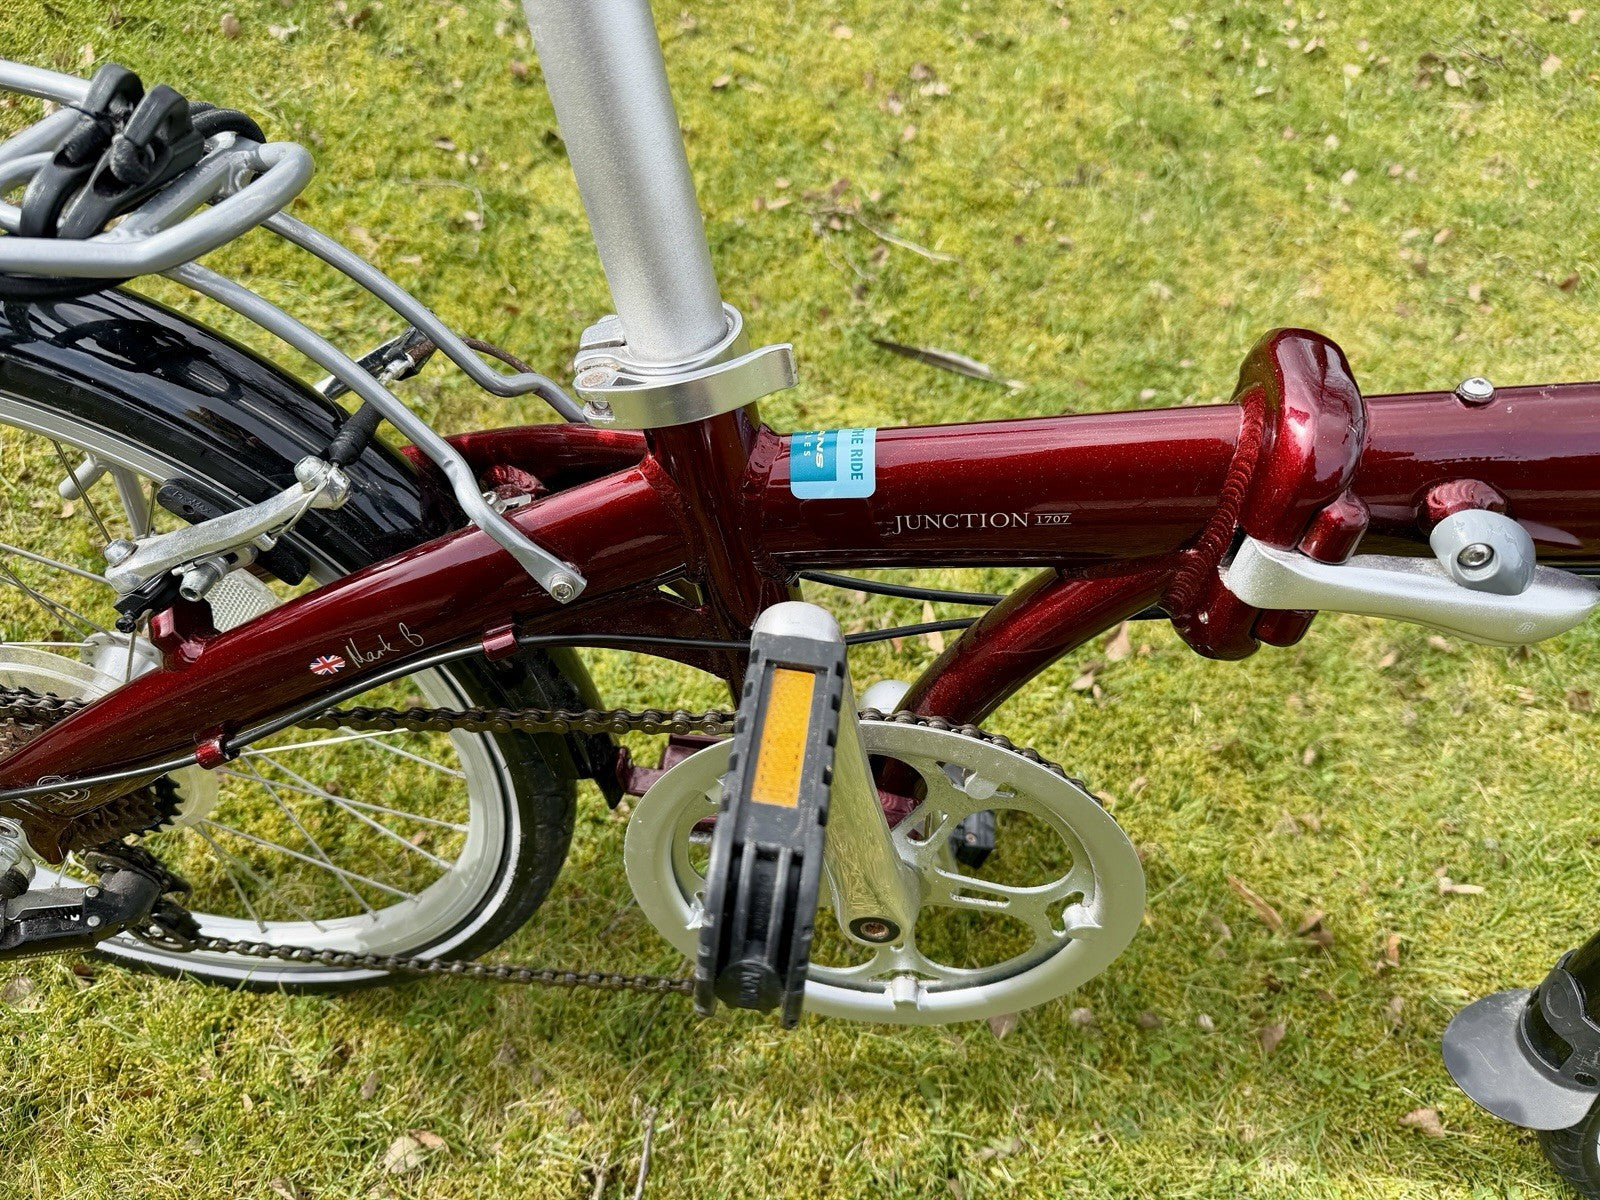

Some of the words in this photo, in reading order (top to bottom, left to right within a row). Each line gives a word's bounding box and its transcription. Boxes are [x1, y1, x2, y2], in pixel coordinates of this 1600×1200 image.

[850, 449, 864, 481] RIDE
[894, 512, 1030, 535] JUNCTION
[1035, 514, 1070, 525] 1707
[345, 635, 401, 669] Mark
[398, 622, 424, 647] B
